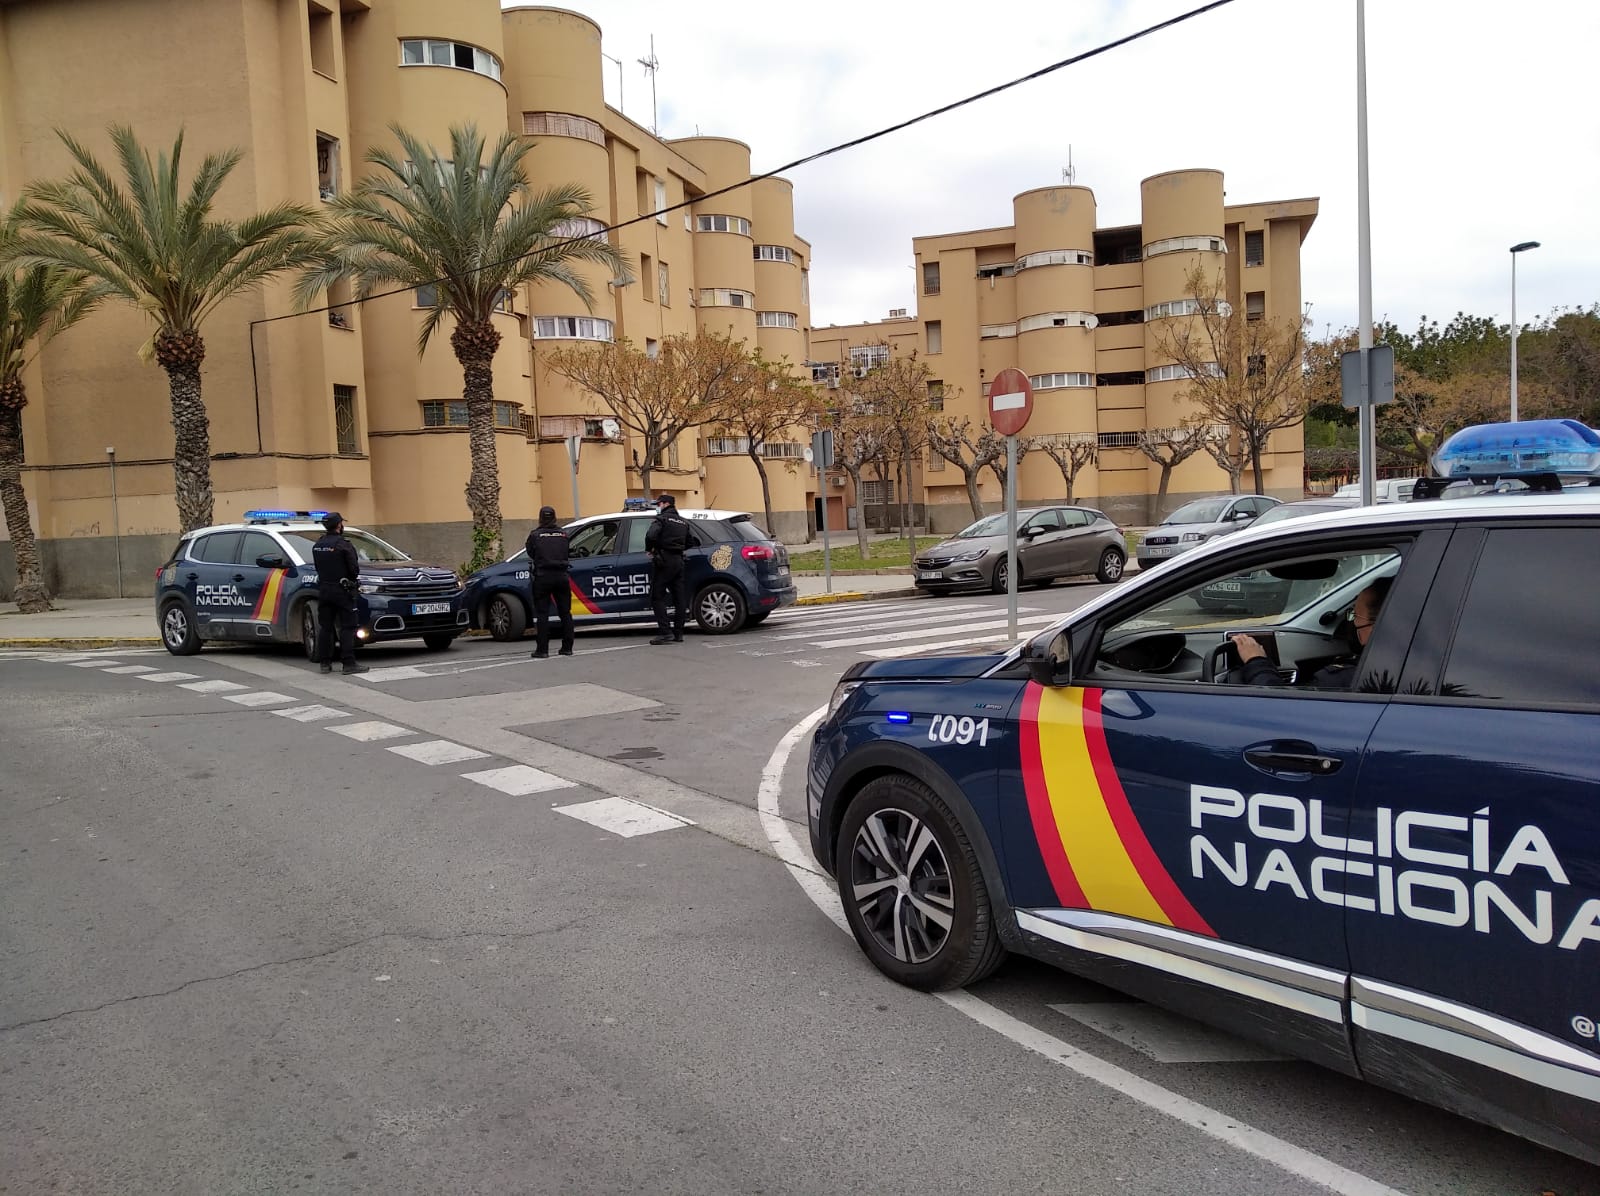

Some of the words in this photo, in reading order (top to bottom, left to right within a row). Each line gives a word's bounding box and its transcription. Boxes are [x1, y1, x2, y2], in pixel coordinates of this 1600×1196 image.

[592, 574, 649, 586] POLICI
[196, 596, 252, 606] NACIONAL
[939, 715, 989, 747] 091
[1190, 784, 1571, 886] POLICÍA
[1190, 834, 1600, 951] NACIONA
